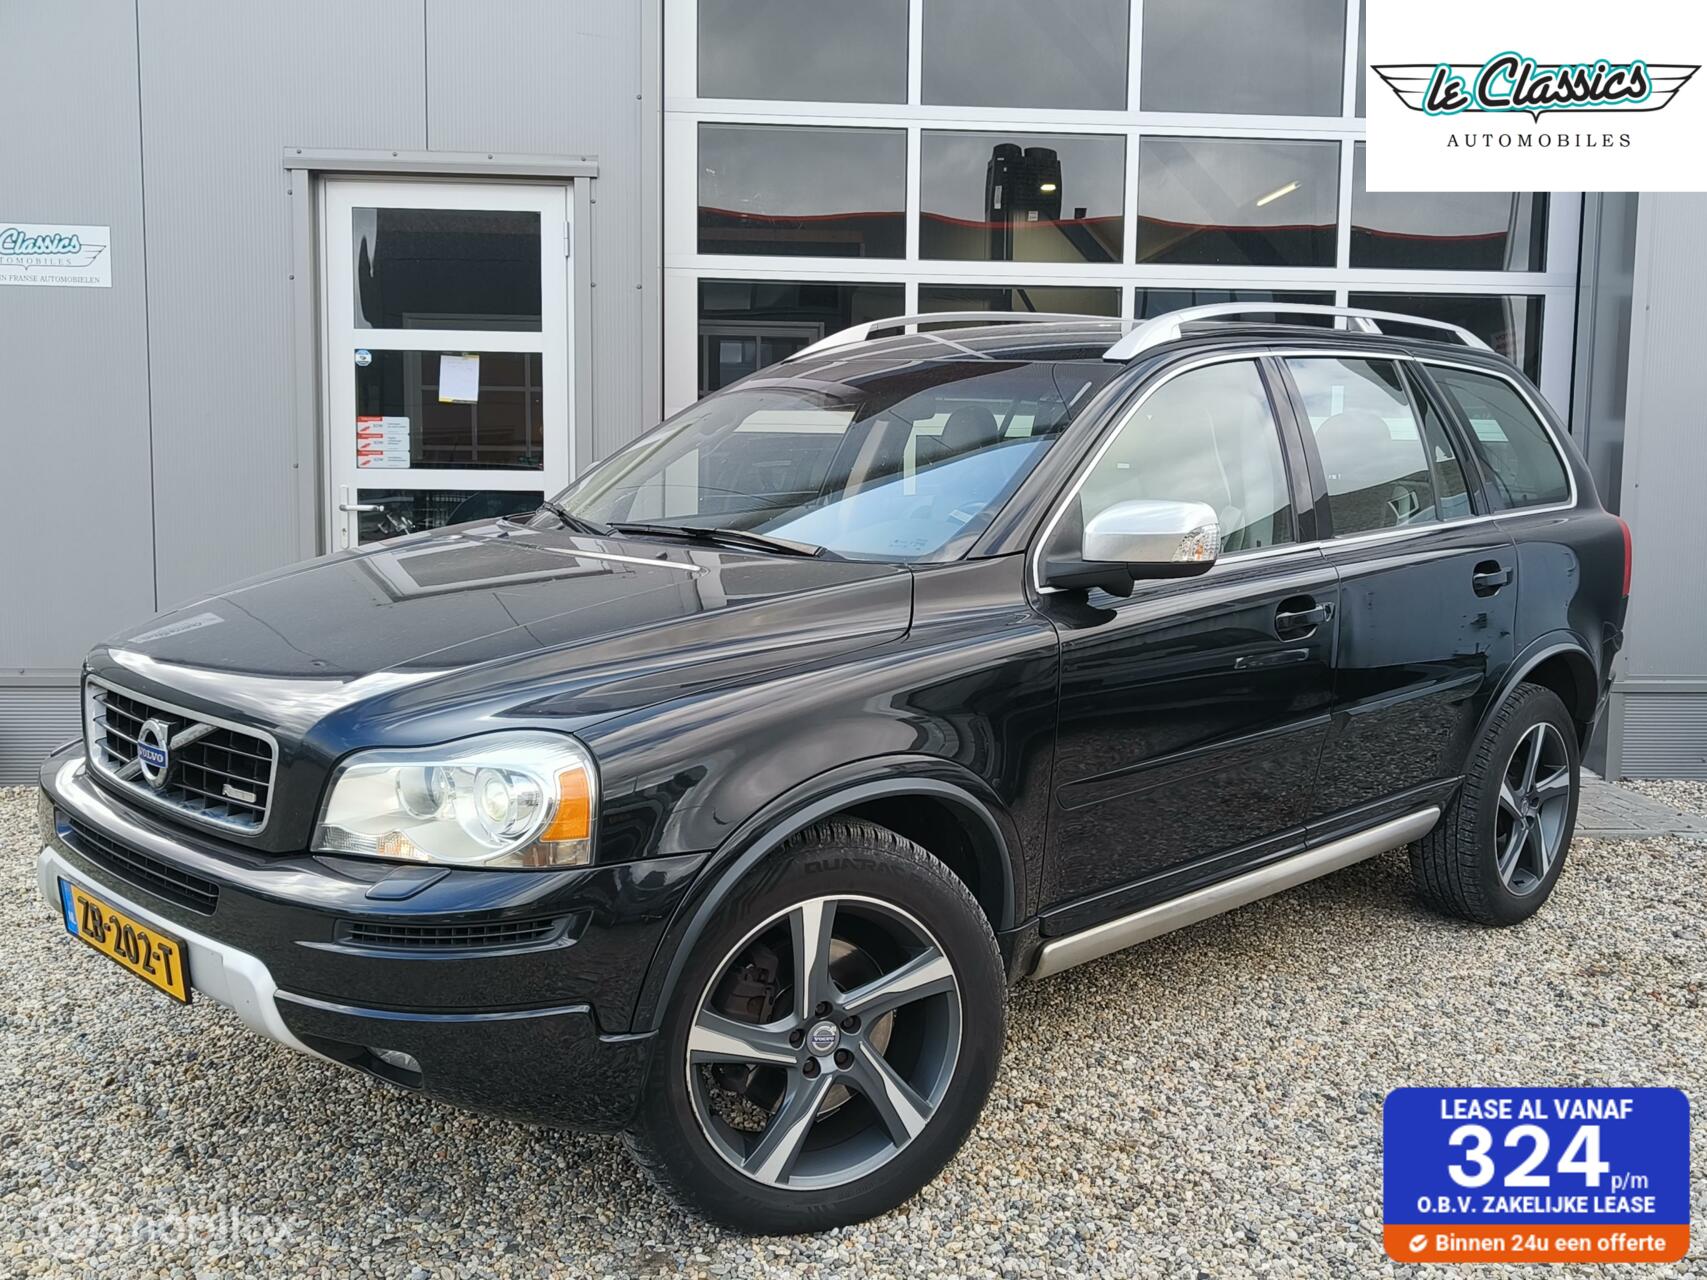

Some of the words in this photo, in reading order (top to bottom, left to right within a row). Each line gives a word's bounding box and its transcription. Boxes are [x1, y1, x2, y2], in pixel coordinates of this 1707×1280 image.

[0, 227, 81, 255] Classics
[138, 745, 164, 763] VOLVO
[77, 895, 174, 986] ZB-202-T
